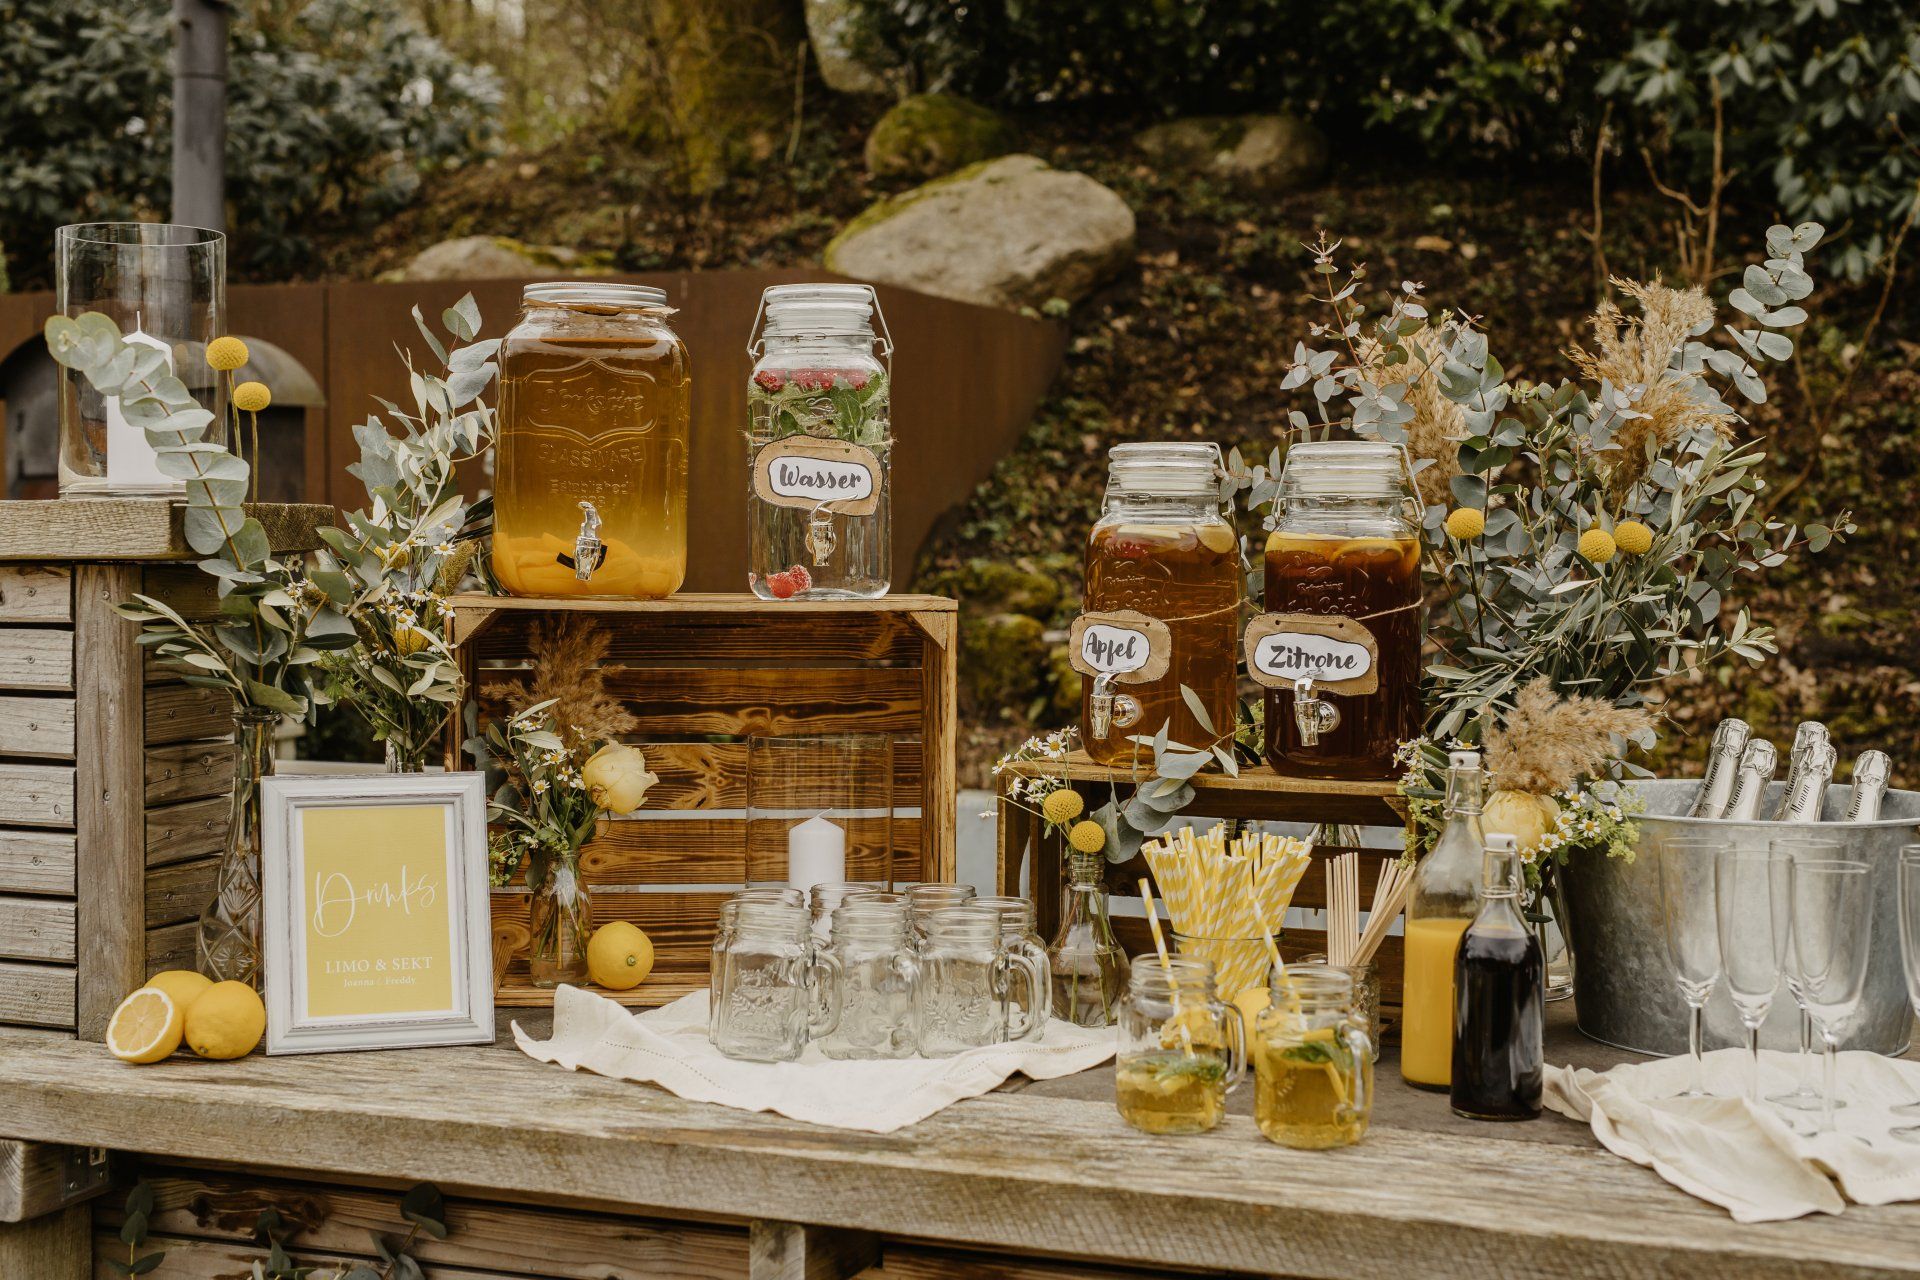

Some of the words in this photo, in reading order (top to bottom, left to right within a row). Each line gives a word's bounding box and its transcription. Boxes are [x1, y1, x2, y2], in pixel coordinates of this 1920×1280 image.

[537, 443, 644, 470] GLASSWARE
[779, 463, 862, 489] Wasser
[1085, 631, 1137, 667] Apfel
[1268, 644, 1358, 670] Zitrone
[1703, 761, 1721, 799] Mumm
[1727, 780, 1746, 817] Mumm
[1790, 784, 1812, 820] Mumm
[1847, 791, 1864, 822] Mumm
[313, 864, 439, 938] Drinks
[325, 958, 370, 974] LIMO
[375, 958, 387, 972] &
[392, 956, 433, 971] SEKT
[385, 976, 417, 986] Freddy
